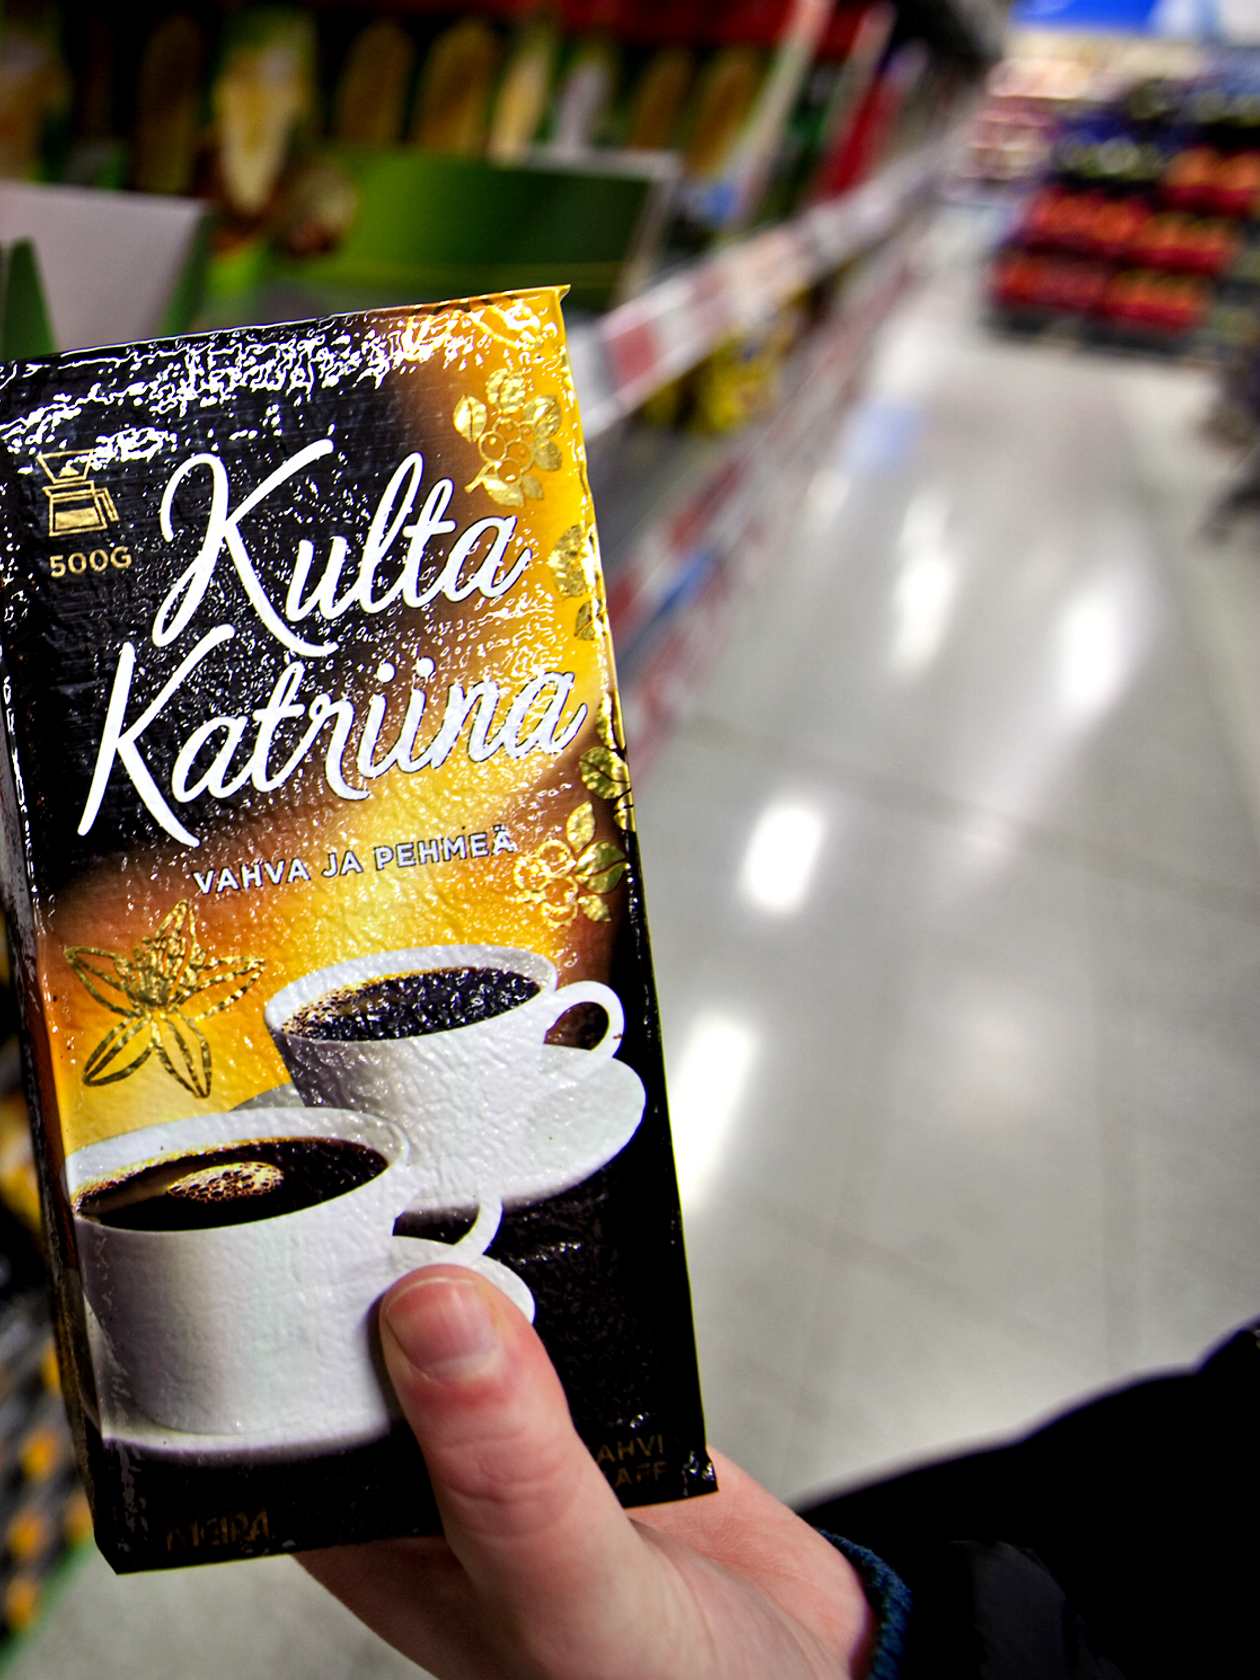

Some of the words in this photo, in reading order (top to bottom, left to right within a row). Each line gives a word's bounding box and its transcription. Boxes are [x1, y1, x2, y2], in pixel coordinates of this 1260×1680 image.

[49, 546, 132, 578] 500G
[152, 439, 532, 659] Kulta
[77, 623, 588, 848] Katriina
[193, 857, 311, 895] VAHVA
[321, 850, 363, 878] JA
[374, 824, 516, 871] PEHMEÄ
[596, 1433, 665, 1465] AHVI
[614, 1459, 668, 1489] AFF
